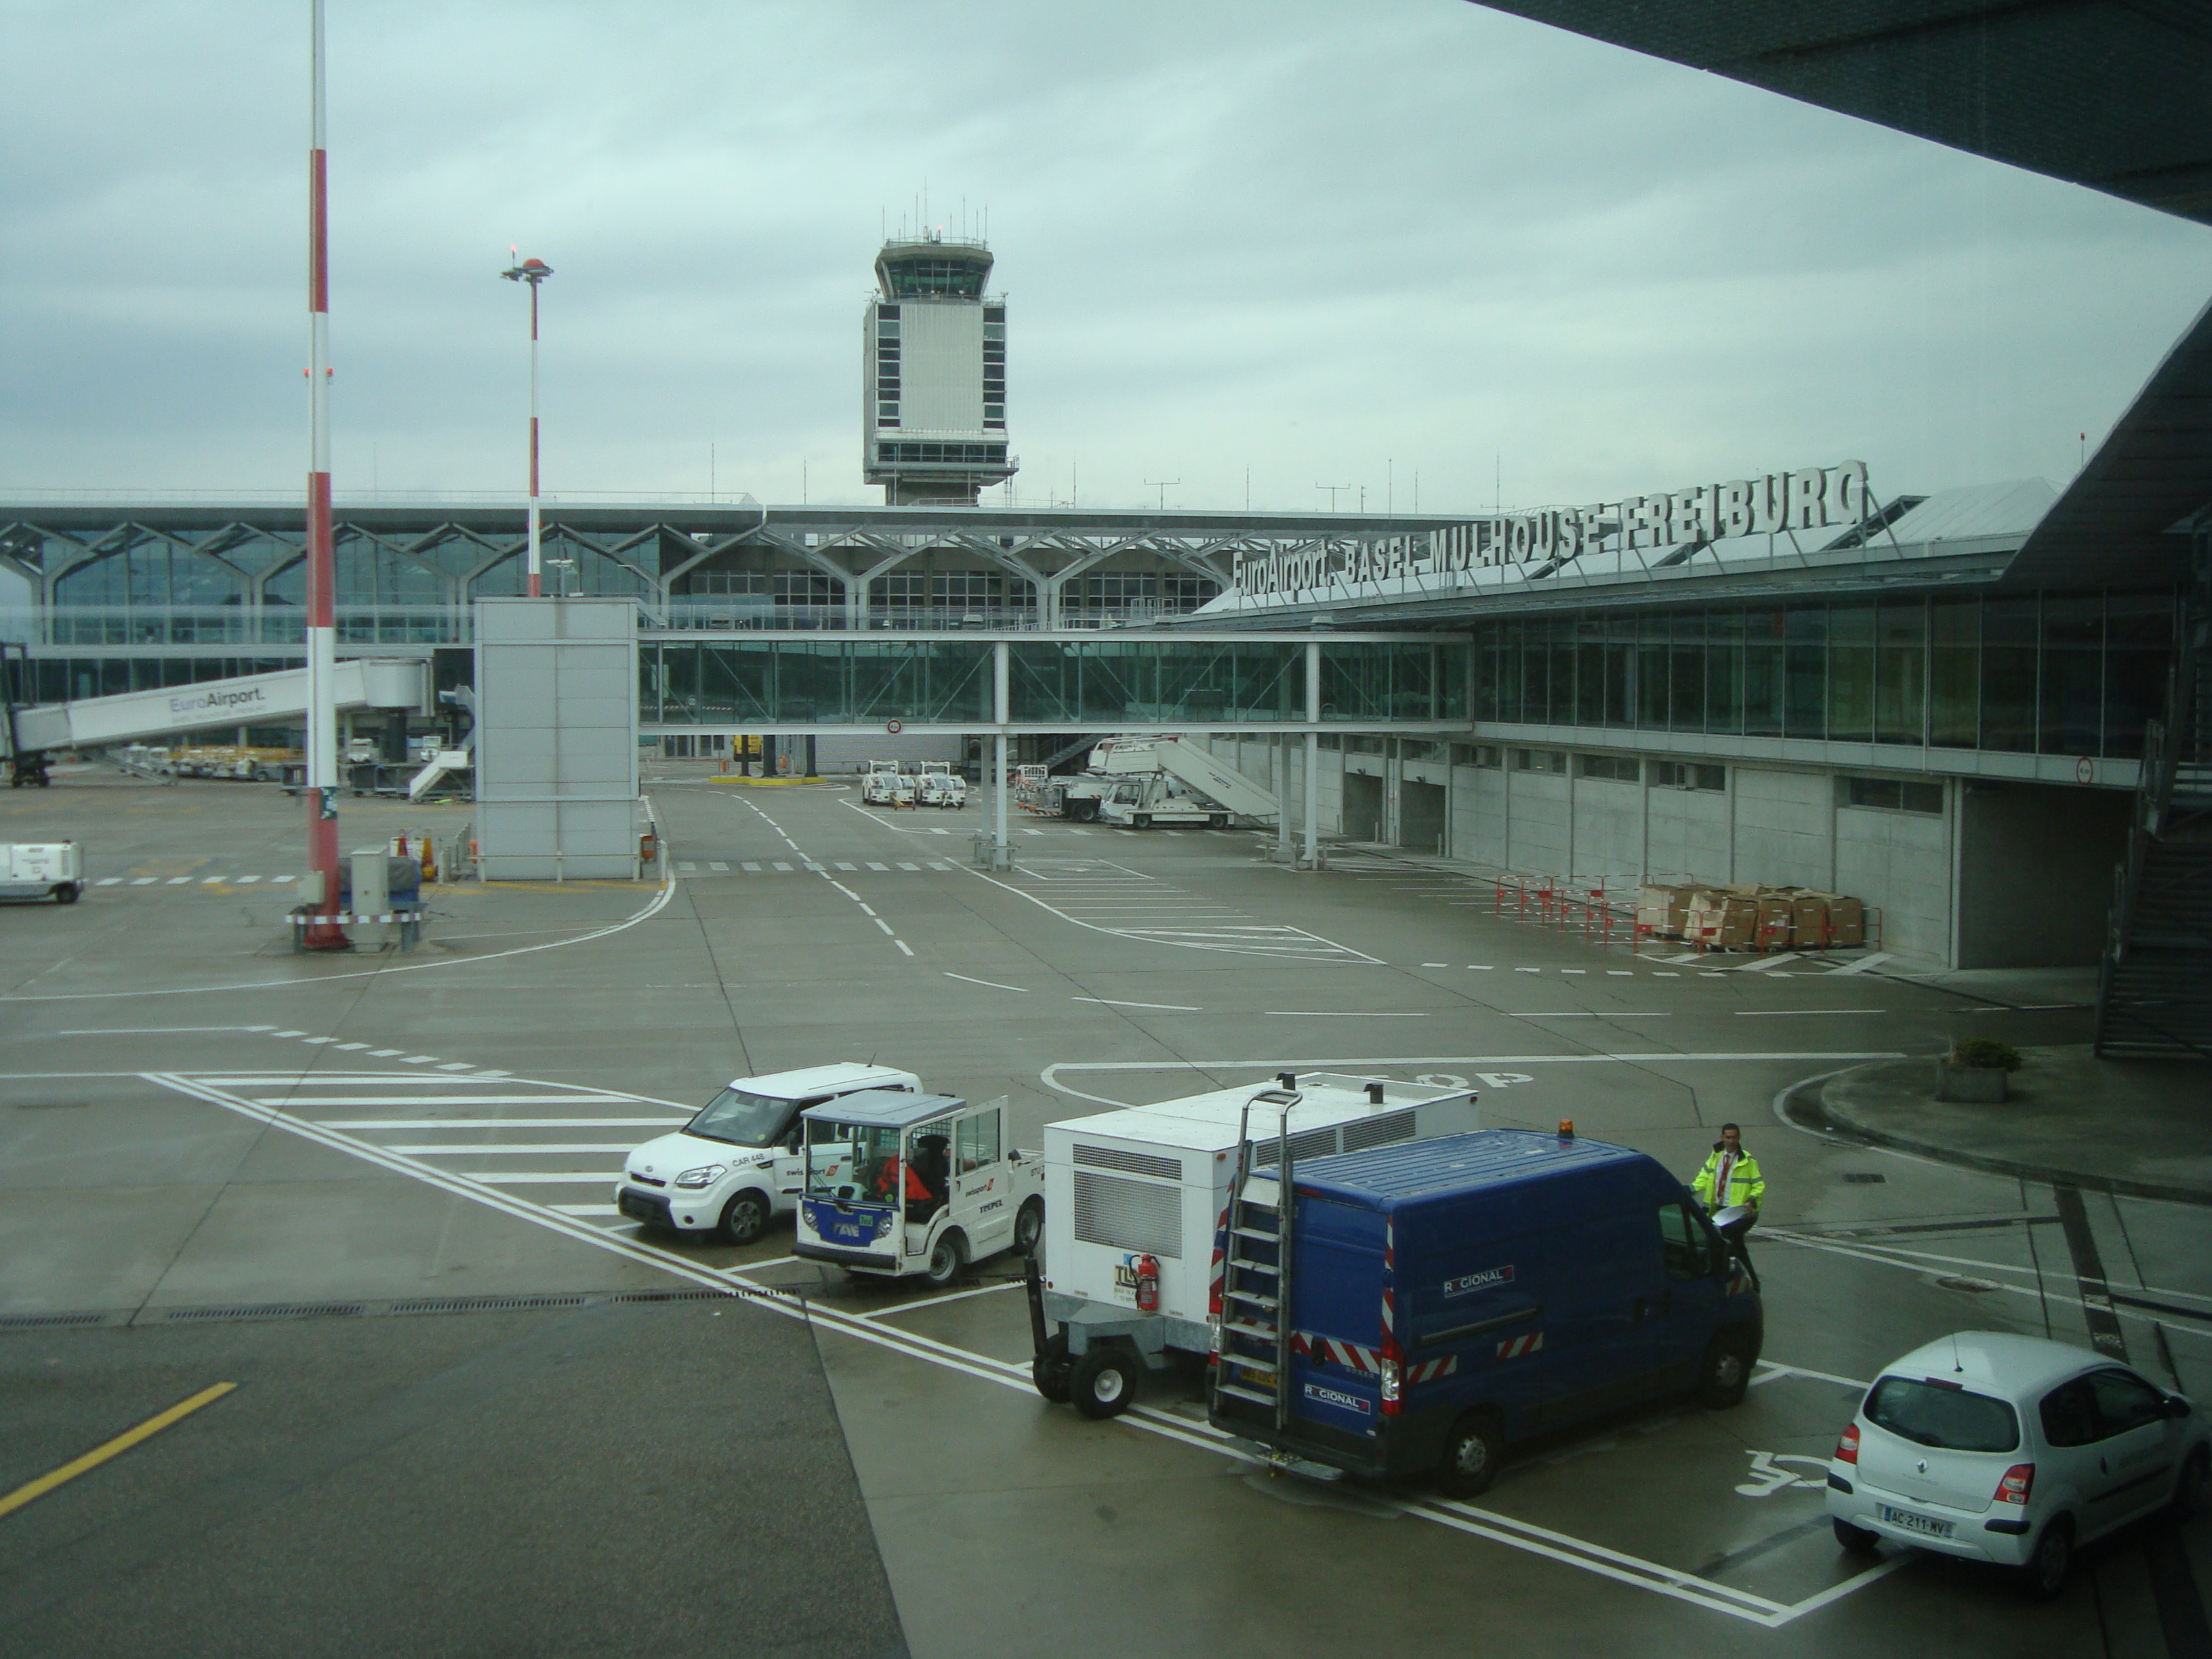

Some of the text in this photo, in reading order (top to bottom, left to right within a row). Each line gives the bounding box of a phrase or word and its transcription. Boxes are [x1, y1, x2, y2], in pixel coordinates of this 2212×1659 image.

[1345, 535, 1419, 584] BASEL
[1429, 503, 1604, 574] MULHOUSE
[1623, 459, 1869, 551] FREIBURG
[733, 1157, 750, 1167] CAR
